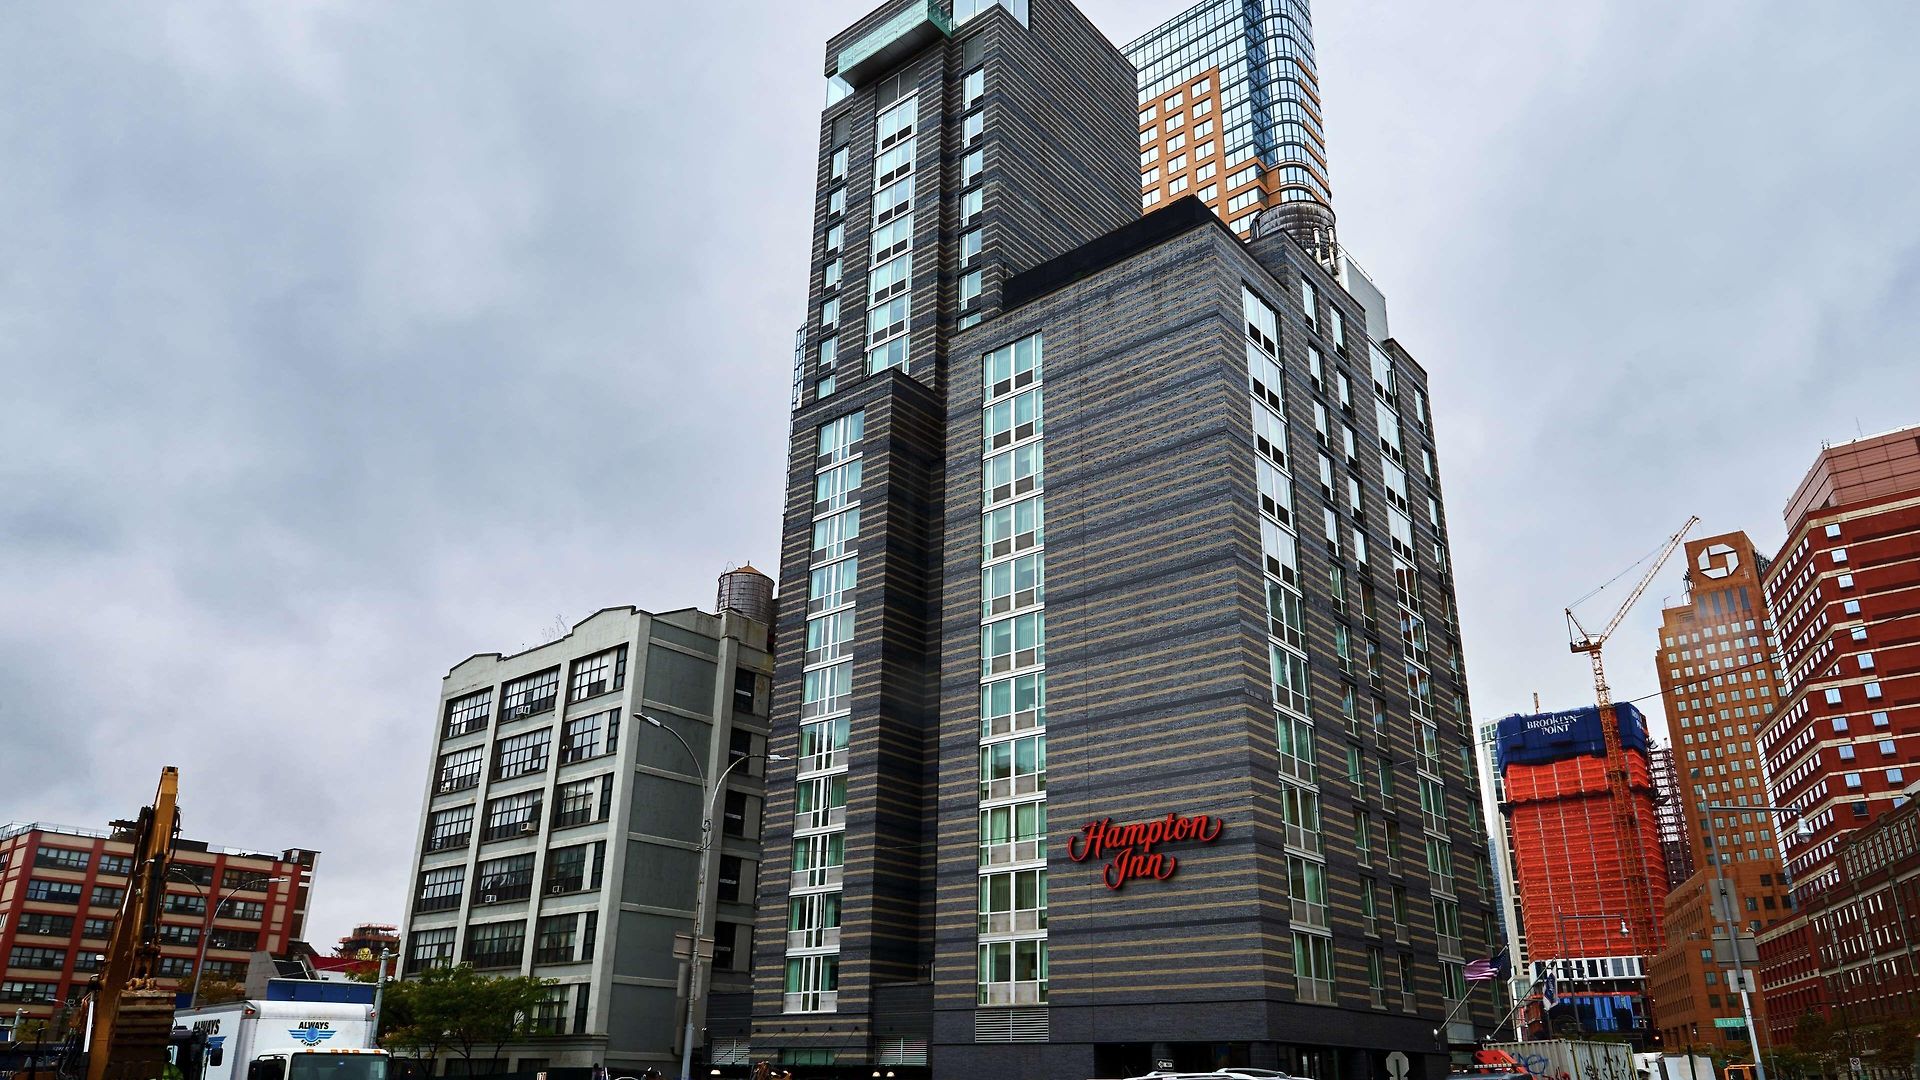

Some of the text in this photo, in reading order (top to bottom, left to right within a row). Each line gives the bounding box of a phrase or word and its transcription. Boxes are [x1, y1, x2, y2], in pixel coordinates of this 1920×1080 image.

[1527, 714, 1577, 729] BROOKLYN
[1541, 723, 1570, 735] POINT
[1067, 812, 1223, 862] Hampton
[1103, 847, 1177, 890] Inn
[298, 1021, 330, 1030] ALWAYS
